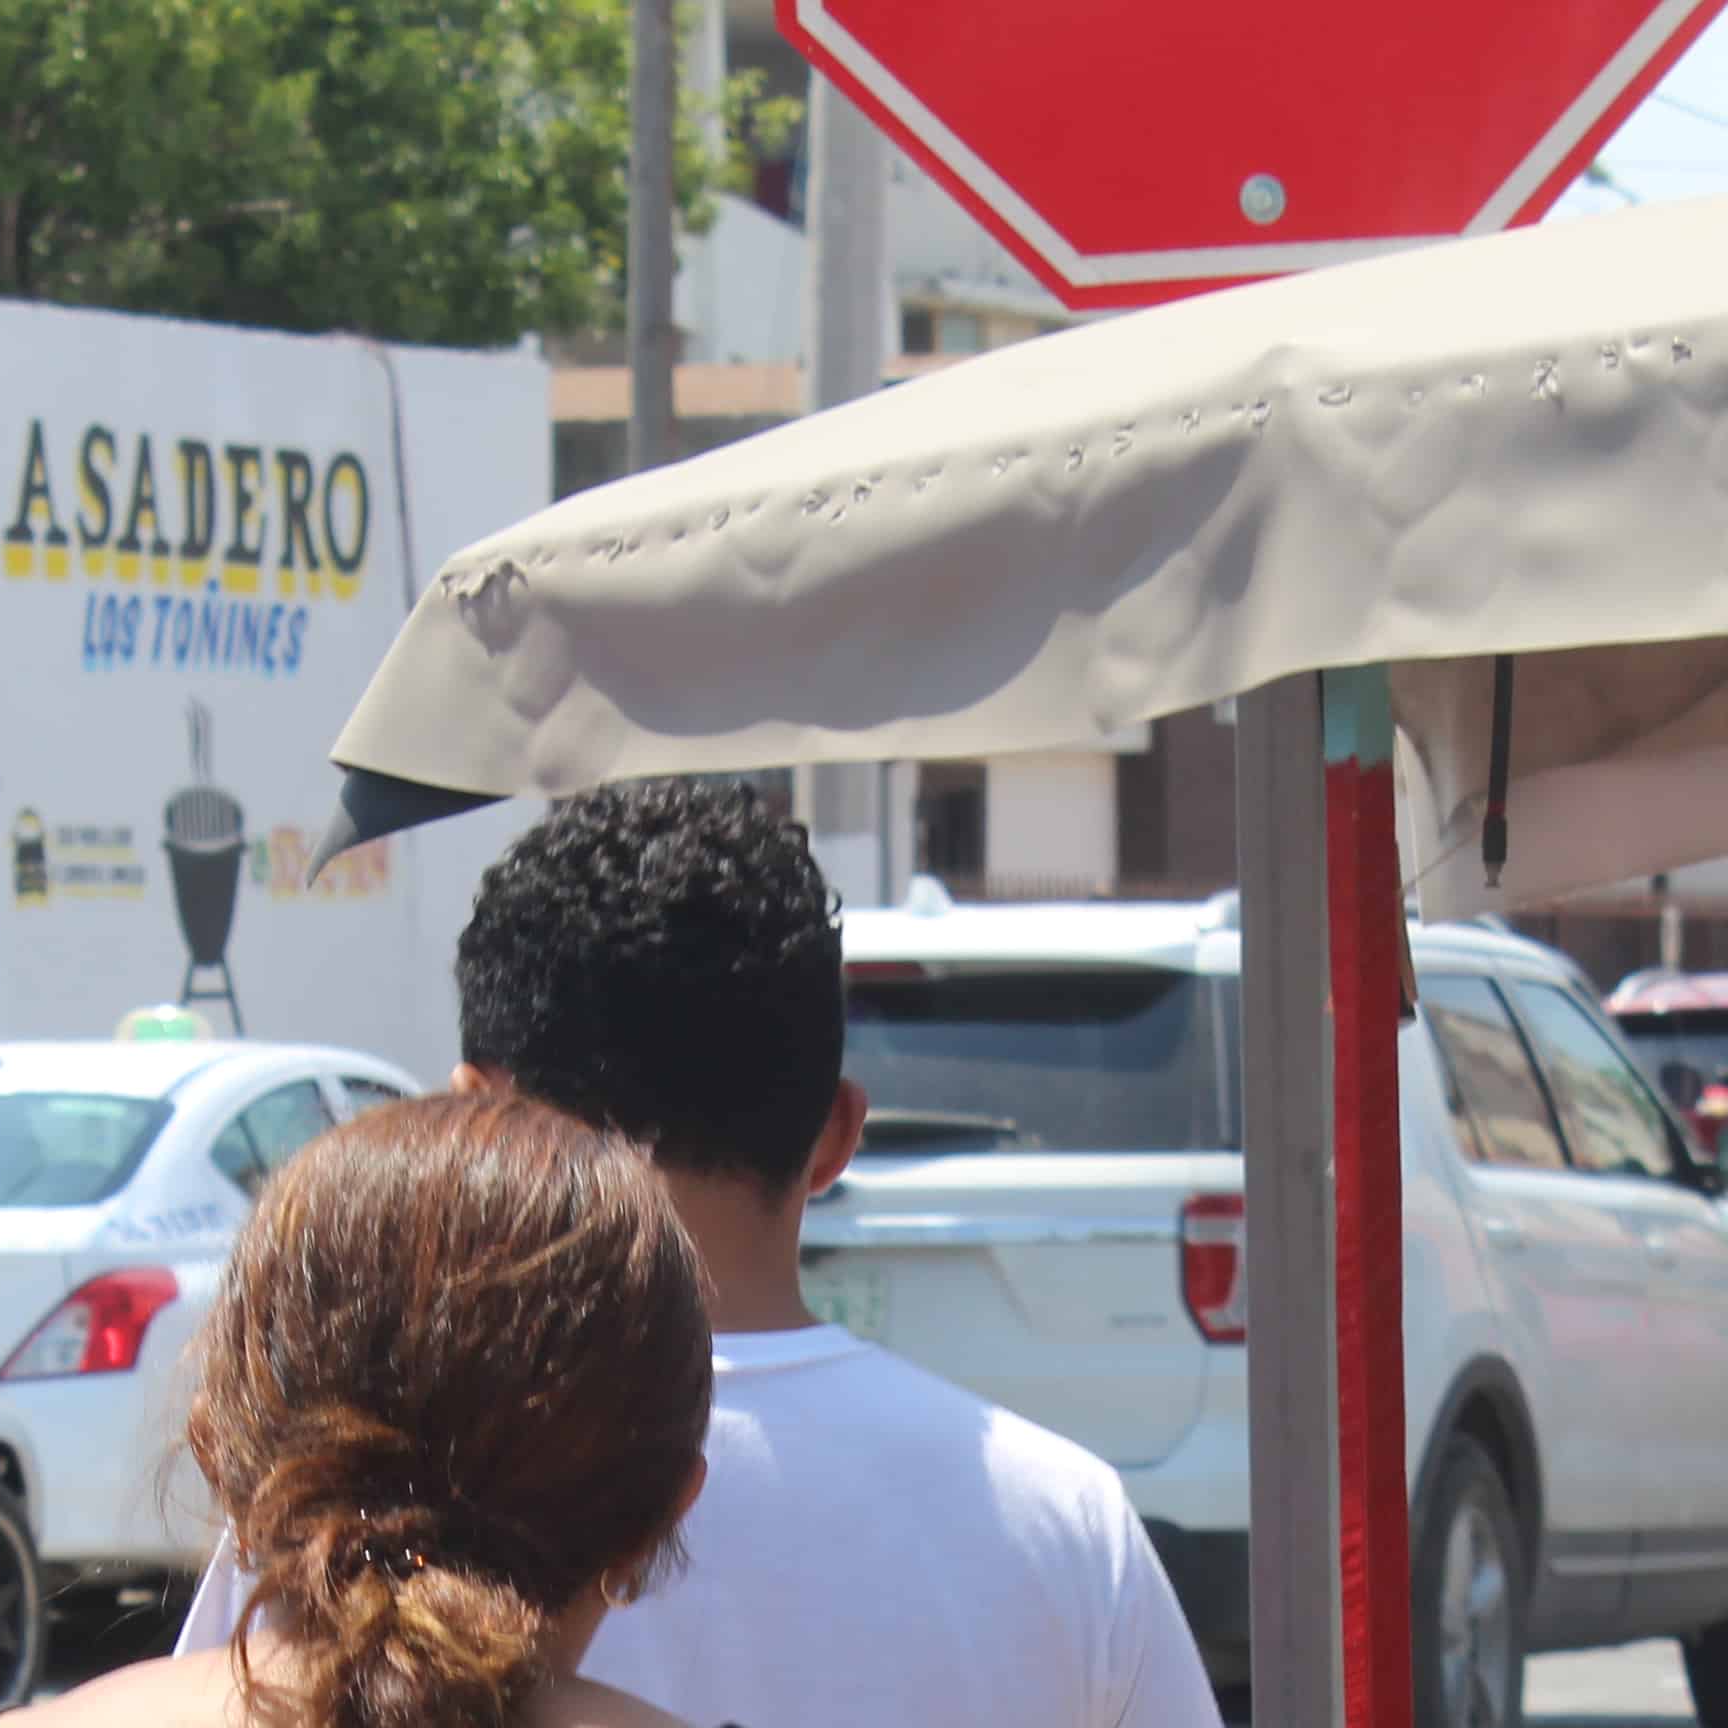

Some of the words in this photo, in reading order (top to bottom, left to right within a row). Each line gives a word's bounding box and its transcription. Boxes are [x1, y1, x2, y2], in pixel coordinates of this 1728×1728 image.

[2, 417, 370, 597] ASADERO
[81, 591, 141, 671] LOS
[150, 578, 308, 678] TOÑINES
